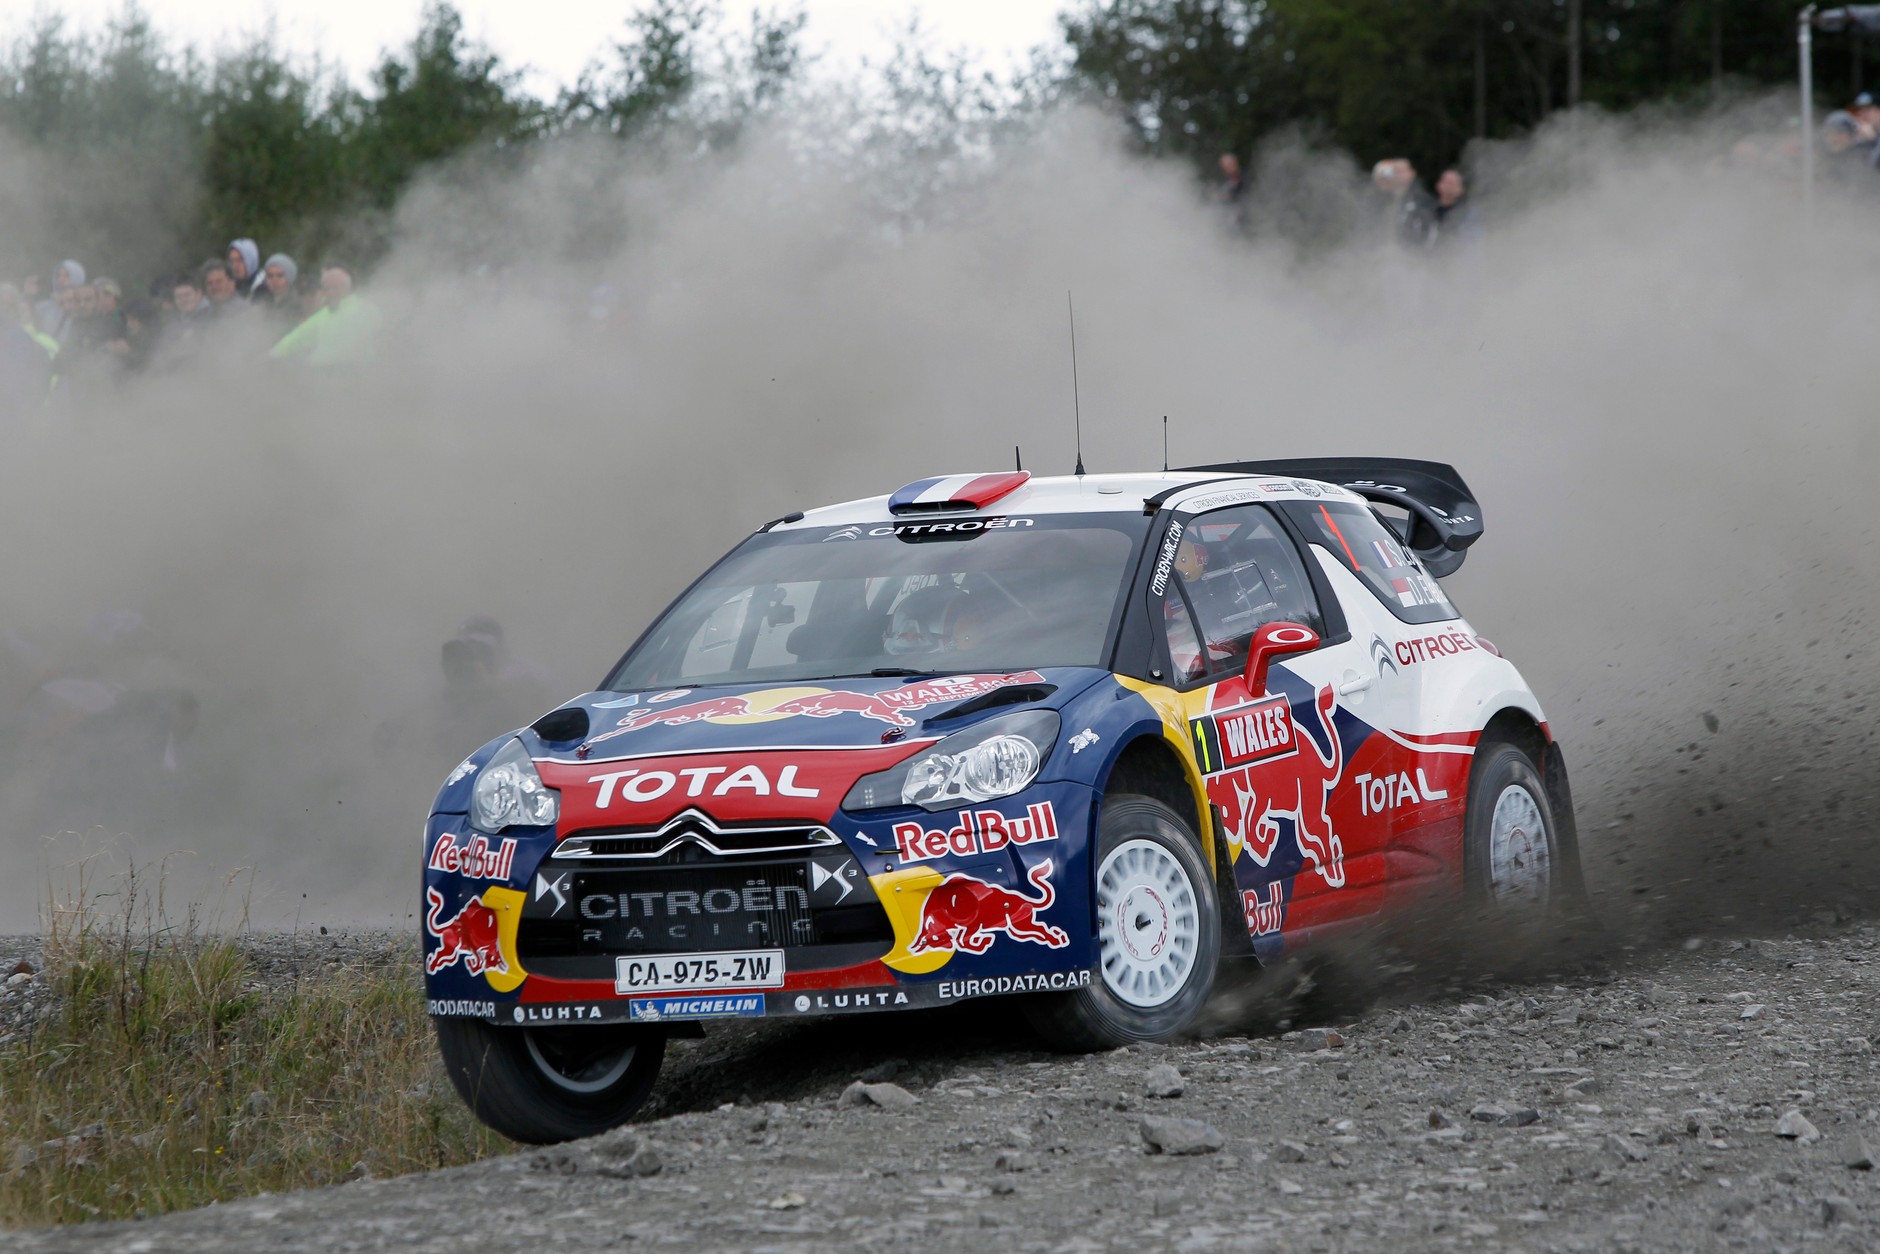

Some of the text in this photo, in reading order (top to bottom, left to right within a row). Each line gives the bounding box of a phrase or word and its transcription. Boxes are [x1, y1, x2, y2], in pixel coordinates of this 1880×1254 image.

[1151, 520, 1184, 597] CITROEN-WRC.COM
[884, 684, 978, 701] WALES
[1195, 706, 1289, 772] 1 WALES
[587, 764, 820, 809] TOTAL
[1355, 768, 1448, 816] TOTAL
[894, 802, 1057, 863] Red Bull
[429, 833, 517, 880] Red Bull
[1243, 880, 1282, 936] Bull
[583, 918, 812, 942] RACING
[628, 957, 771, 986] CA-975-ZW
[938, 970, 1091, 999] EURODATACAR
[528, 1006, 602, 1020] LUHTA
[663, 998, 758, 1014] MICHELIN
[817, 991, 909, 1008] LUHTA
